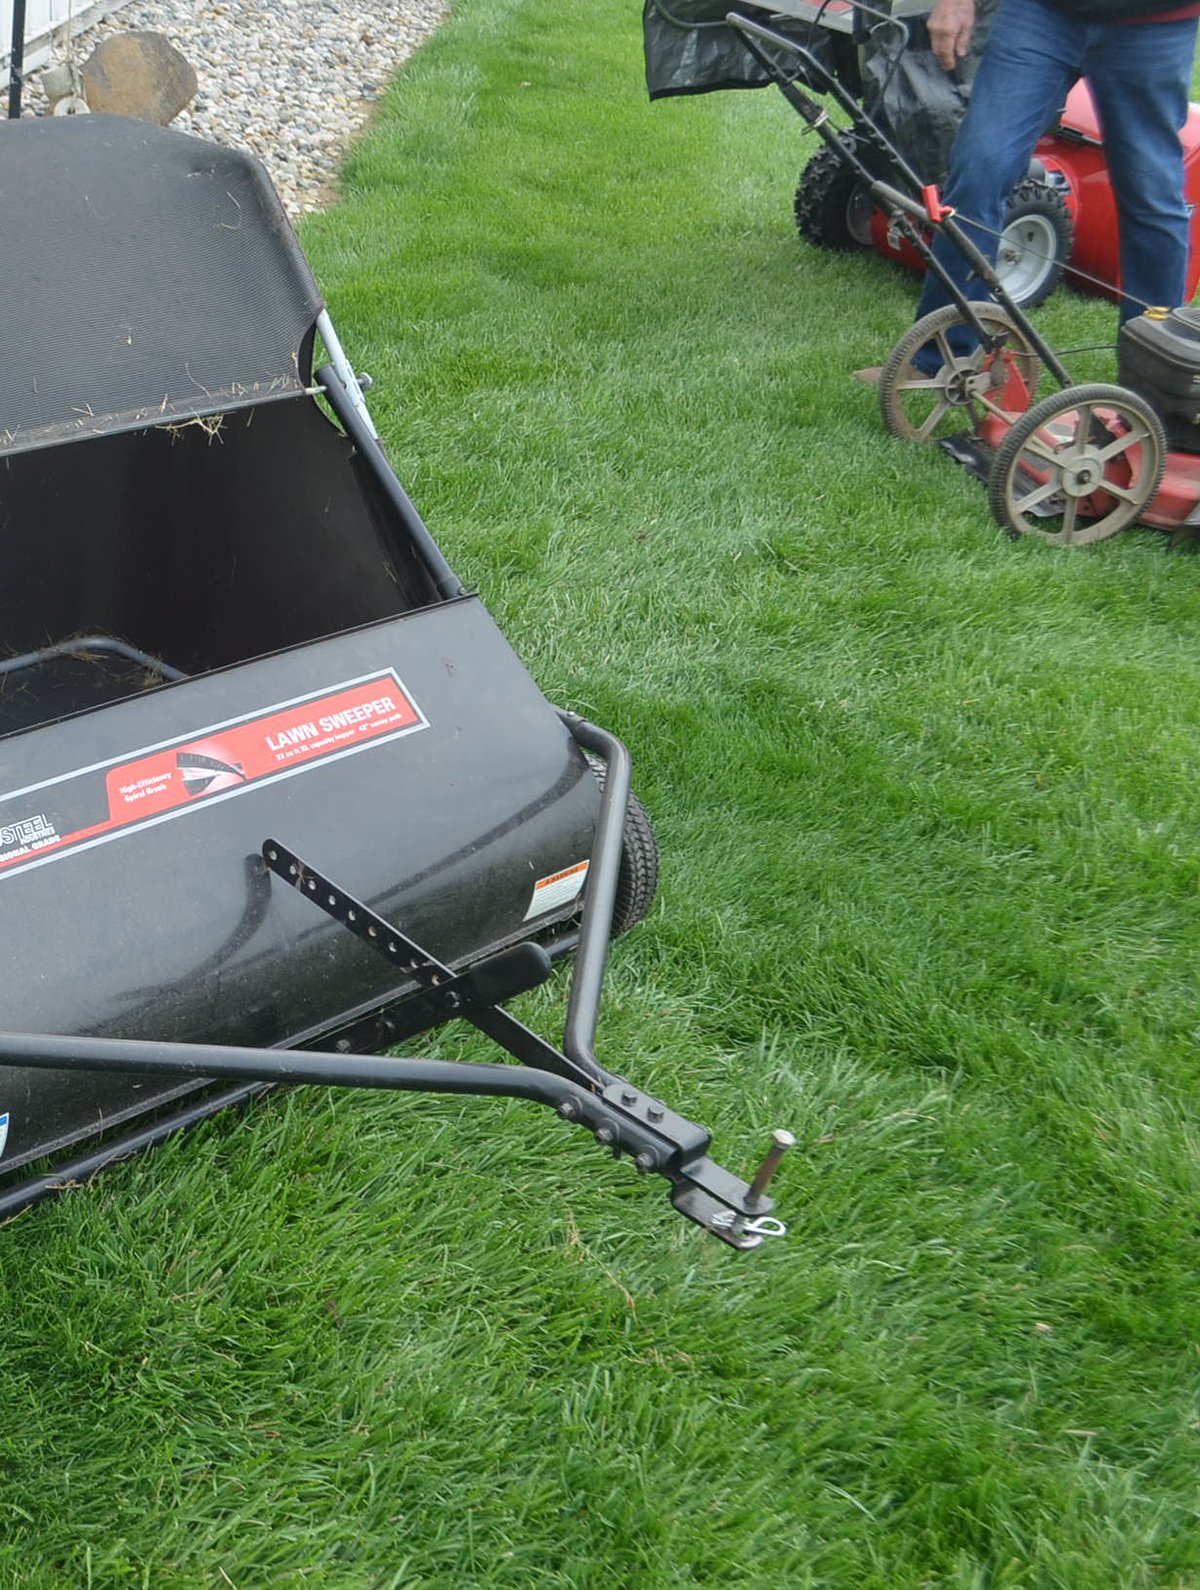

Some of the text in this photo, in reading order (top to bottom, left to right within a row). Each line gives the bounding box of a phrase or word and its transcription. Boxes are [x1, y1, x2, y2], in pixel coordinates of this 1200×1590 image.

[265, 696, 397, 751] LAWN SWEEPER
[32, 834, 62, 851] GRADE
